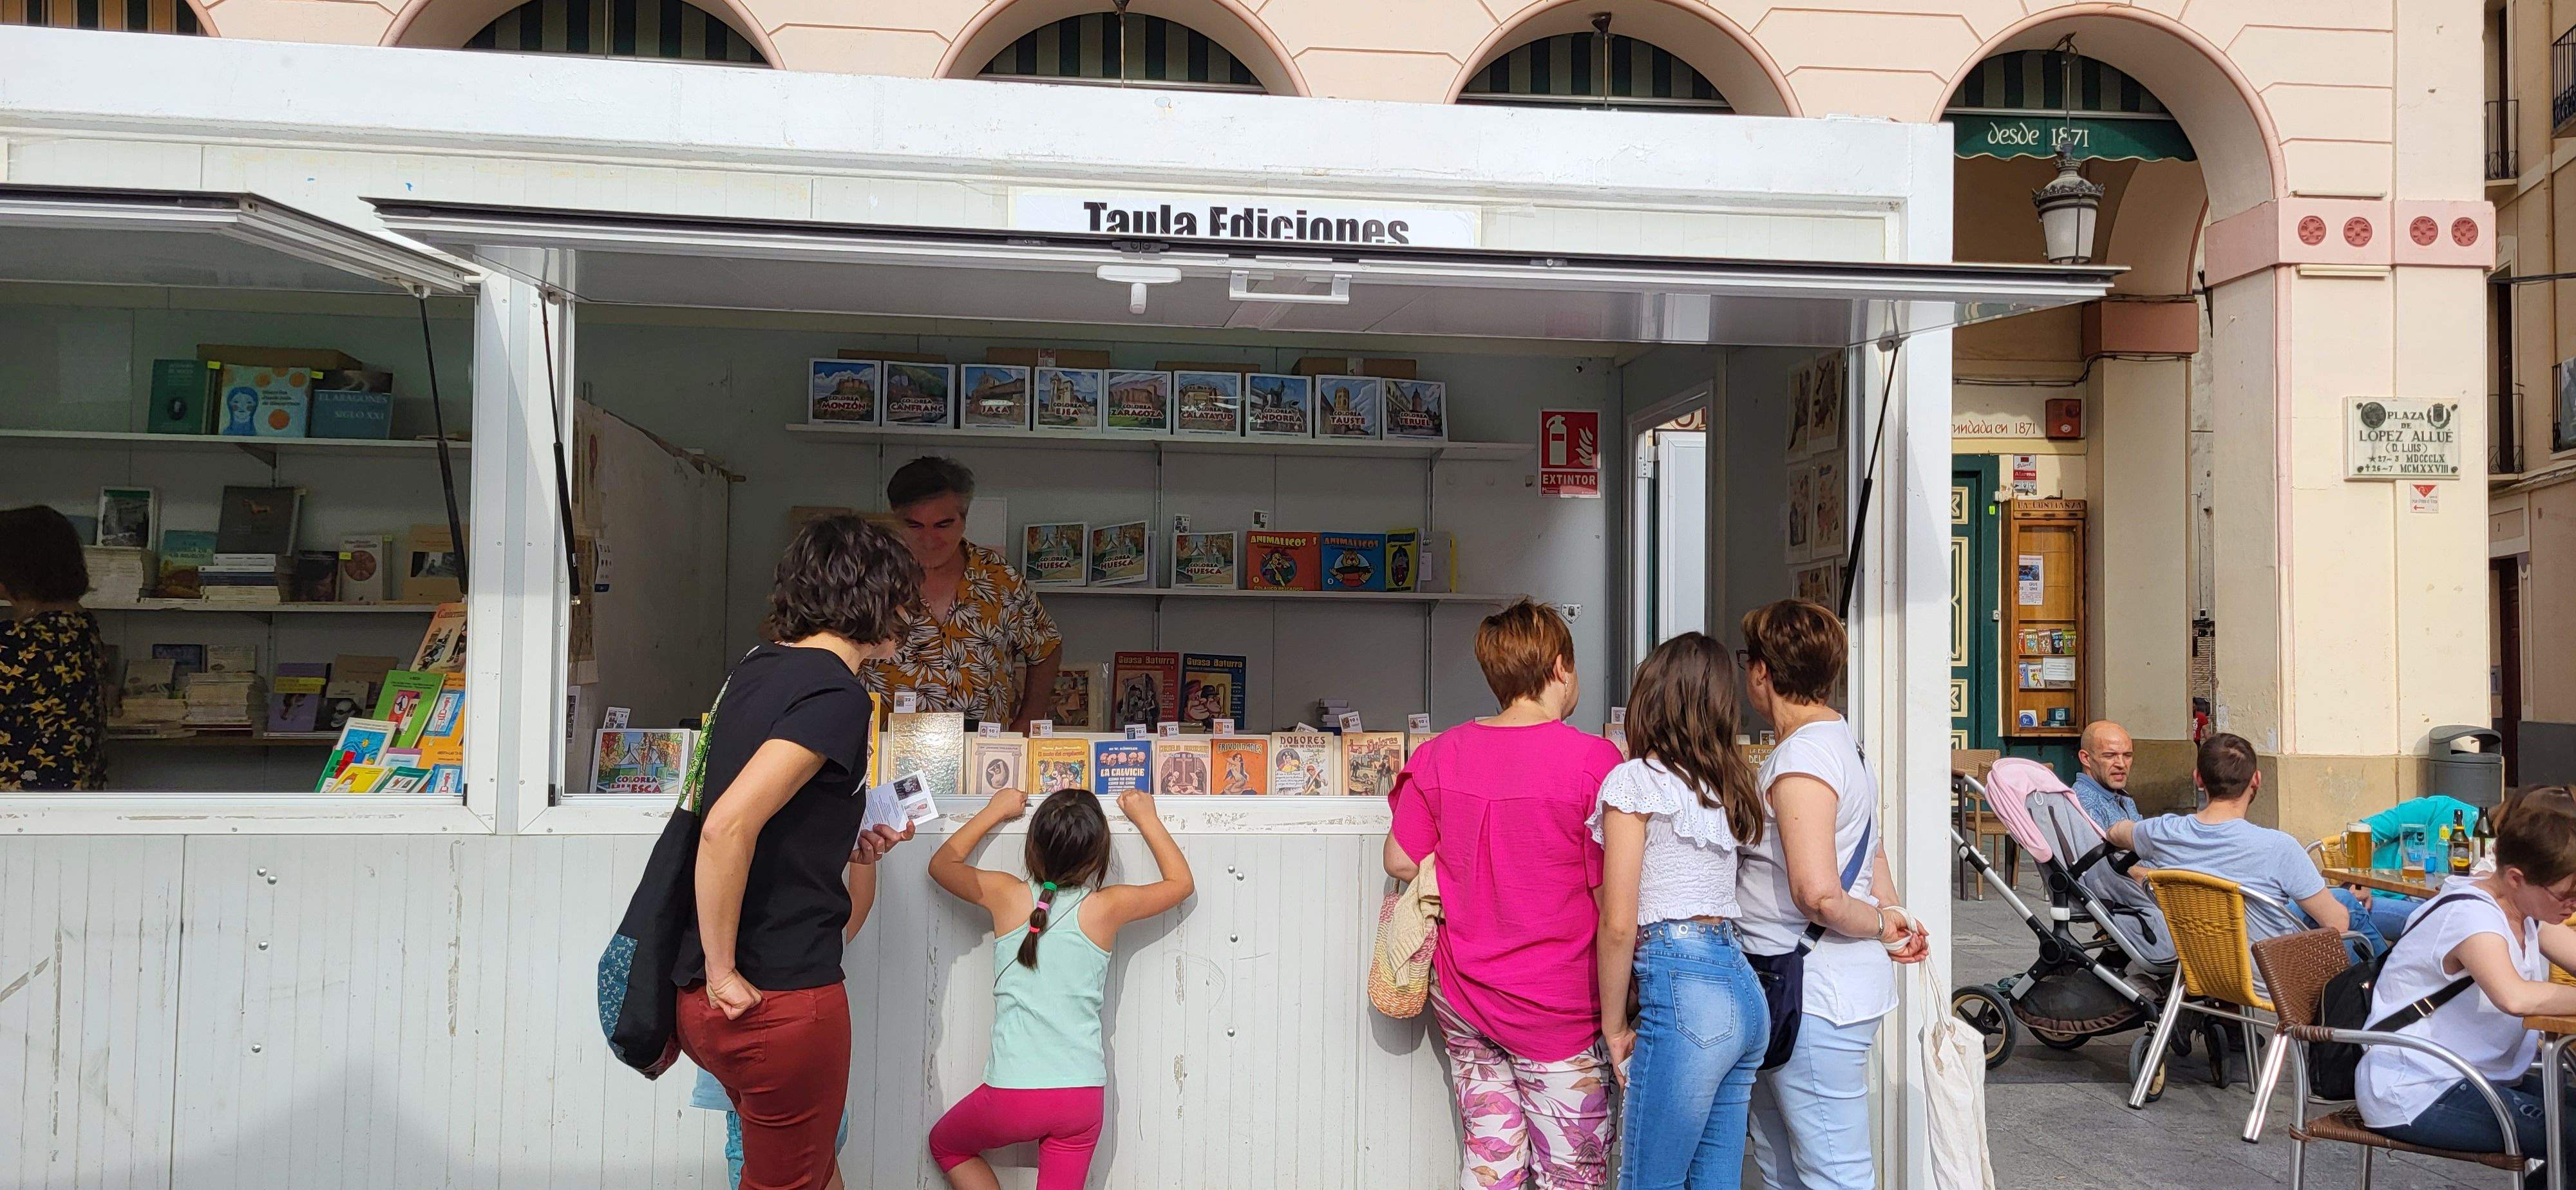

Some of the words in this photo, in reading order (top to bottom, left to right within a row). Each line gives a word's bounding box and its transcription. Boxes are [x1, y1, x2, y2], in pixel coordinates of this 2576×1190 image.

[1987, 121, 2040, 146] desde
[2051, 127, 2089, 148] 1871
[1084, 202, 1197, 236] Taula
[1209, 206, 1410, 245] Ediciones
[821, 400, 866, 411] MONZÓN
[890, 403, 944, 413] CANFRANC
[981, 405, 1010, 414] JACA
[1056, 408, 1080, 417] EJEA
[1110, 409, 1164, 418] ZARAGOZA
[1181, 411, 1235, 420] CALATAYUD
[1254, 413, 1302, 422] ANDORRA
[2387, 411, 2425, 420] PLAZA
[1331, 417, 1366, 425] TAUSTE
[1399, 417, 1431, 426] TERUEL
[1994, 422, 2008, 434] en
[2014, 422, 2036, 436] 1871
[2411, 429, 2454, 443] ALLUÉ
[2402, 443, 2428, 454] LUIS)
[2406, 454, 2445, 463] MDCCCLX
[2400, 464, 2449, 474] MCMXXVIII
[1542, 474, 1596, 486] EXTINTOR
[2017, 500, 2028, 509] LA
[1250, 535, 1307, 547] ANIMALICOS
[1323, 536, 1379, 547] ANIMALICOS
[1100, 559, 1134, 570] HUESCA
[1186, 657, 1211, 667] Guasa
[1213, 658, 1243, 668] Baturra
[1280, 736, 1326, 744] DOLORES
[1217, 742, 1263, 755] FRIVOLIDADES
[1100, 769, 1110, 777] LA
[1112, 768, 1145, 777] CALVICIE
[616, 775, 658, 784] COLOREA
